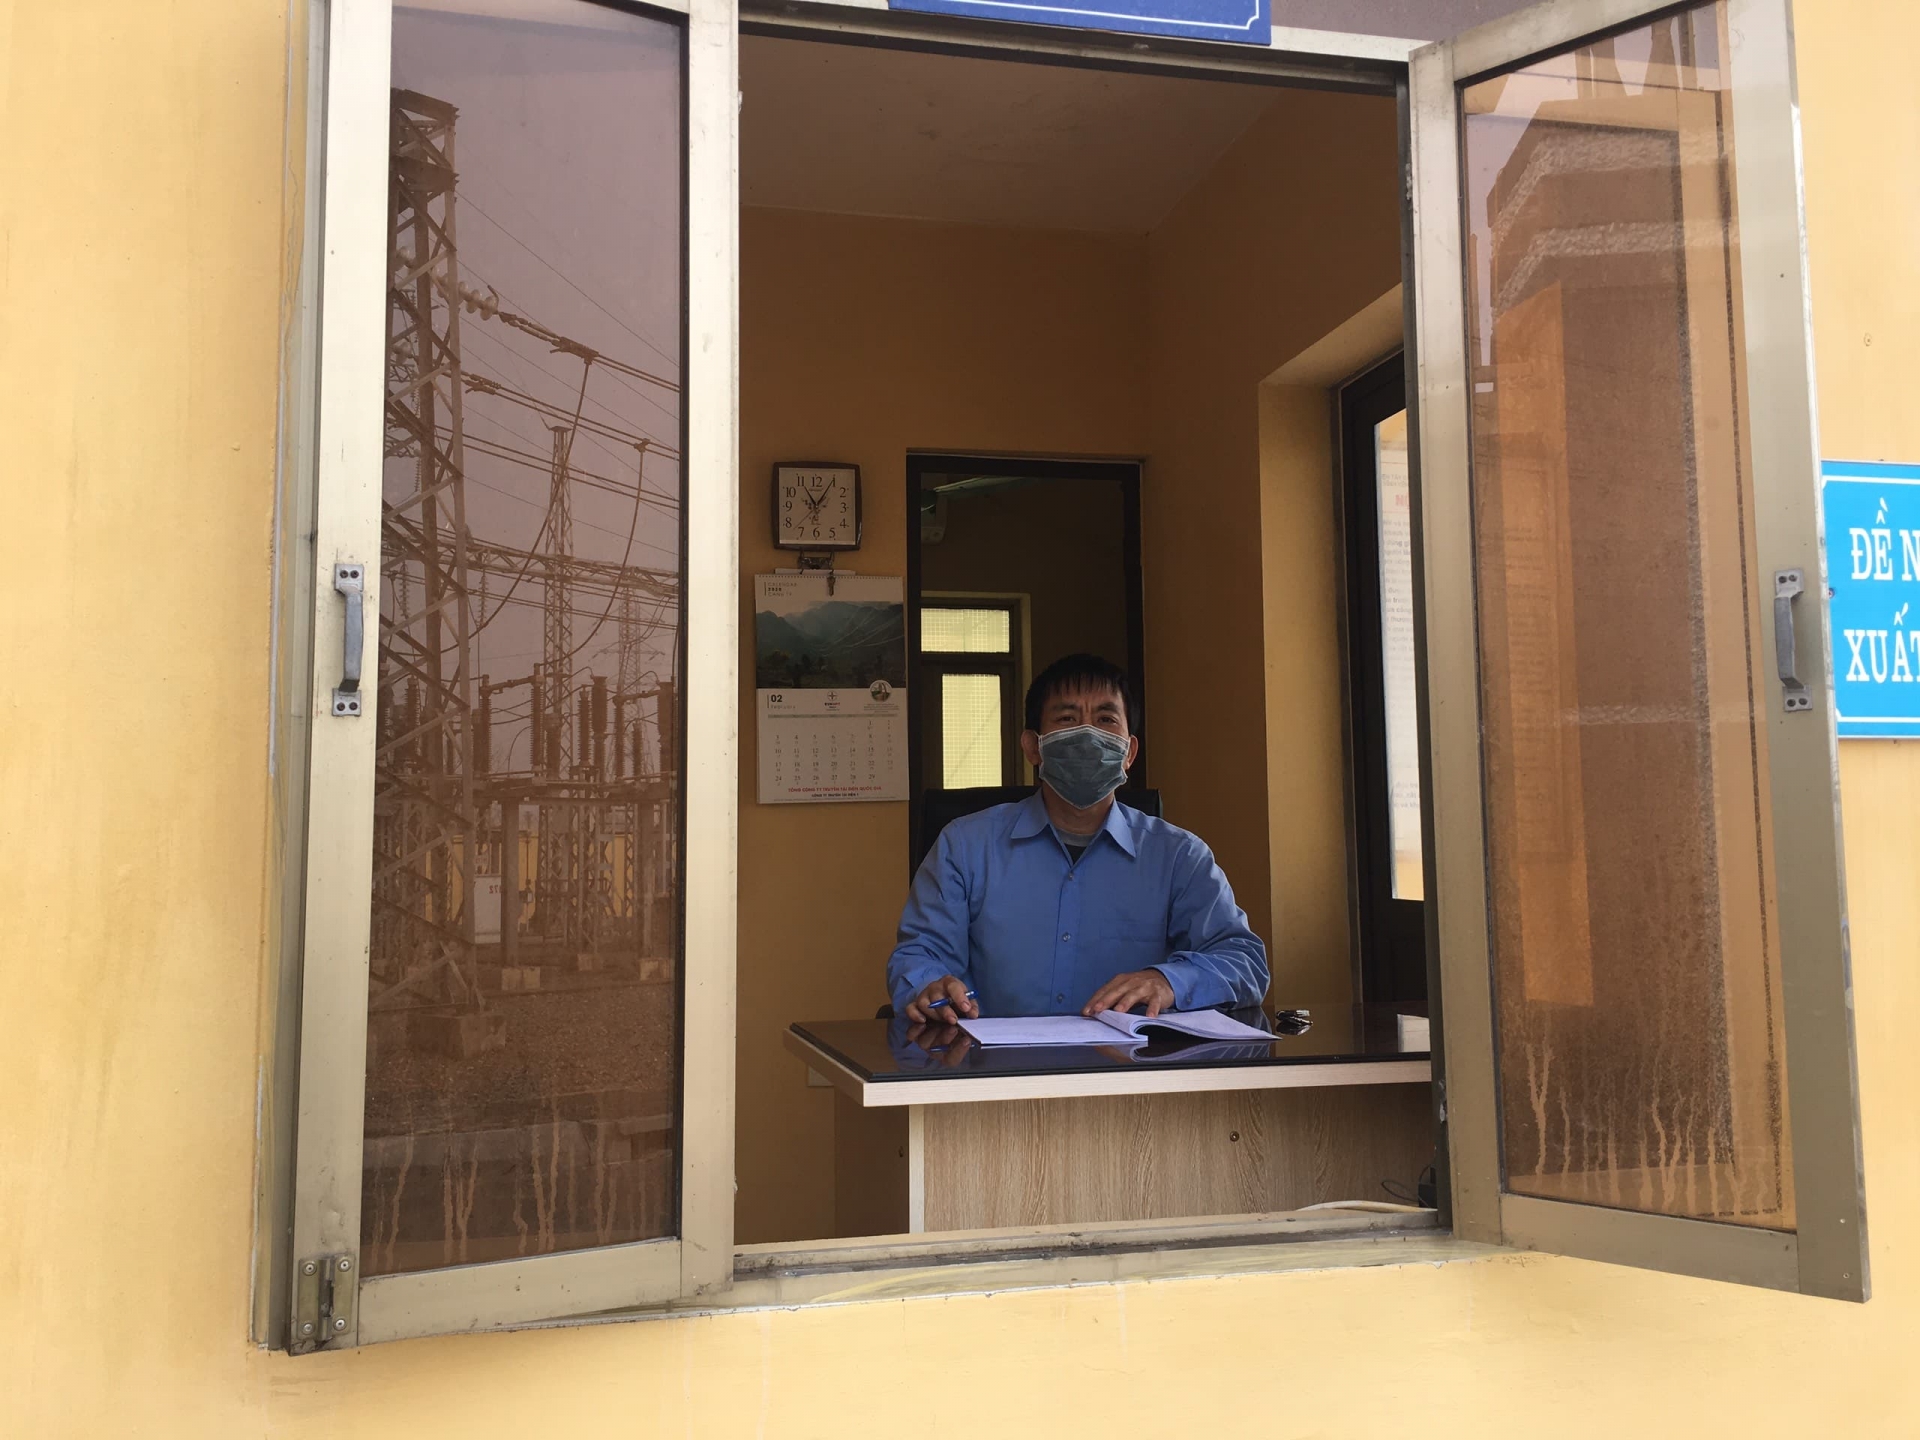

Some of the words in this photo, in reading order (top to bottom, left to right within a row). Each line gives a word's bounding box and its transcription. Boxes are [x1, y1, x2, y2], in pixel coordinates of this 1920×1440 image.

[797, 476, 805, 487] 11
[811, 476, 823, 488] 12
[831, 476, 836, 488] 1
[786, 487, 796, 498] 10
[839, 487, 847, 498] 2
[785, 501, 793, 512] 9
[840, 502, 847, 514] 3
[785, 517, 792, 529] 8
[839, 518, 847, 529] 4
[798, 527, 805, 538] 7
[812, 527, 821, 538] 6
[829, 528, 836, 539] 5
[1849, 497, 1894, 581] ĐỀ
[770, 694, 783, 703] 02
